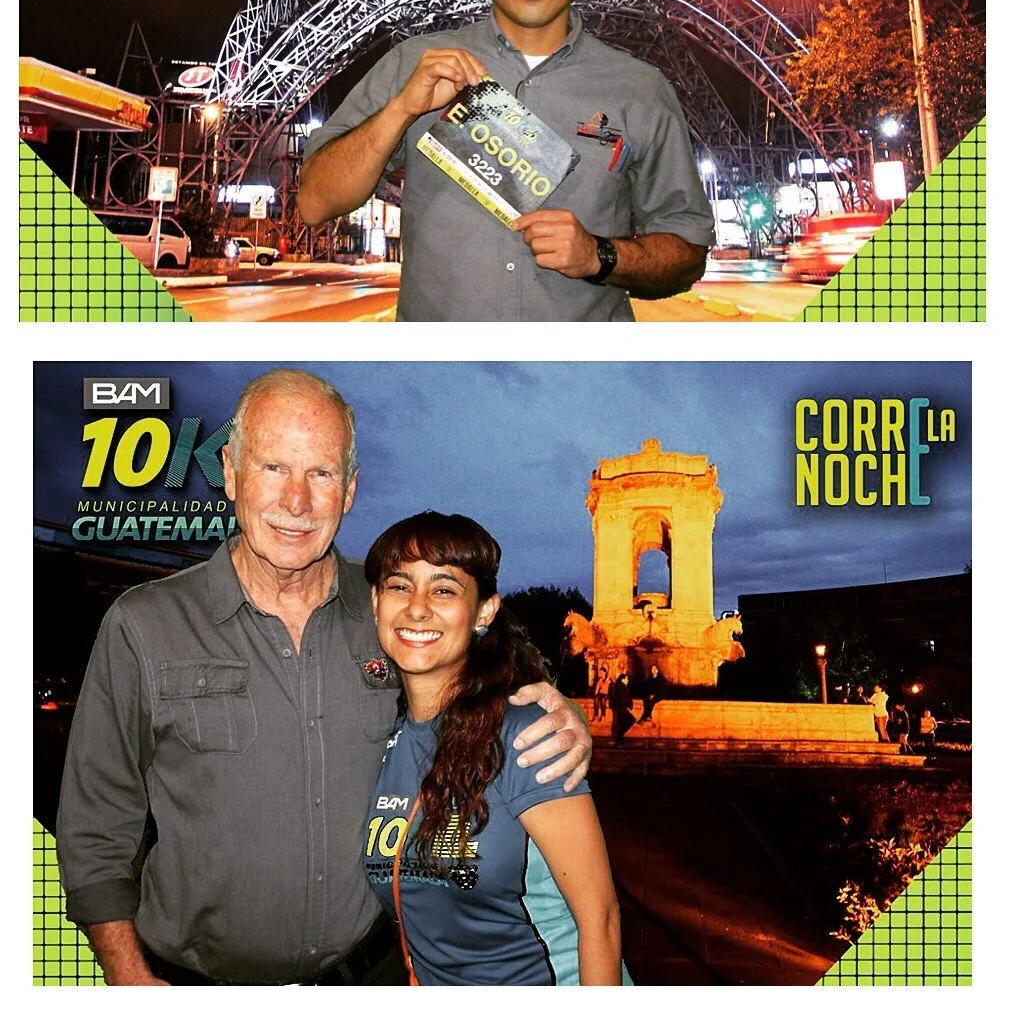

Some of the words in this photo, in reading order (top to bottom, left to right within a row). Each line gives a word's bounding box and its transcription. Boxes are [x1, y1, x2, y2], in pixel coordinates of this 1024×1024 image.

[468, 154, 503, 186] 3223
[471, 124, 551, 197] OSORIO
[458, 177, 479, 197] MEDALLA
[494, 209, 513, 226] MEDALL
[376, 797, 409, 811] BAM
